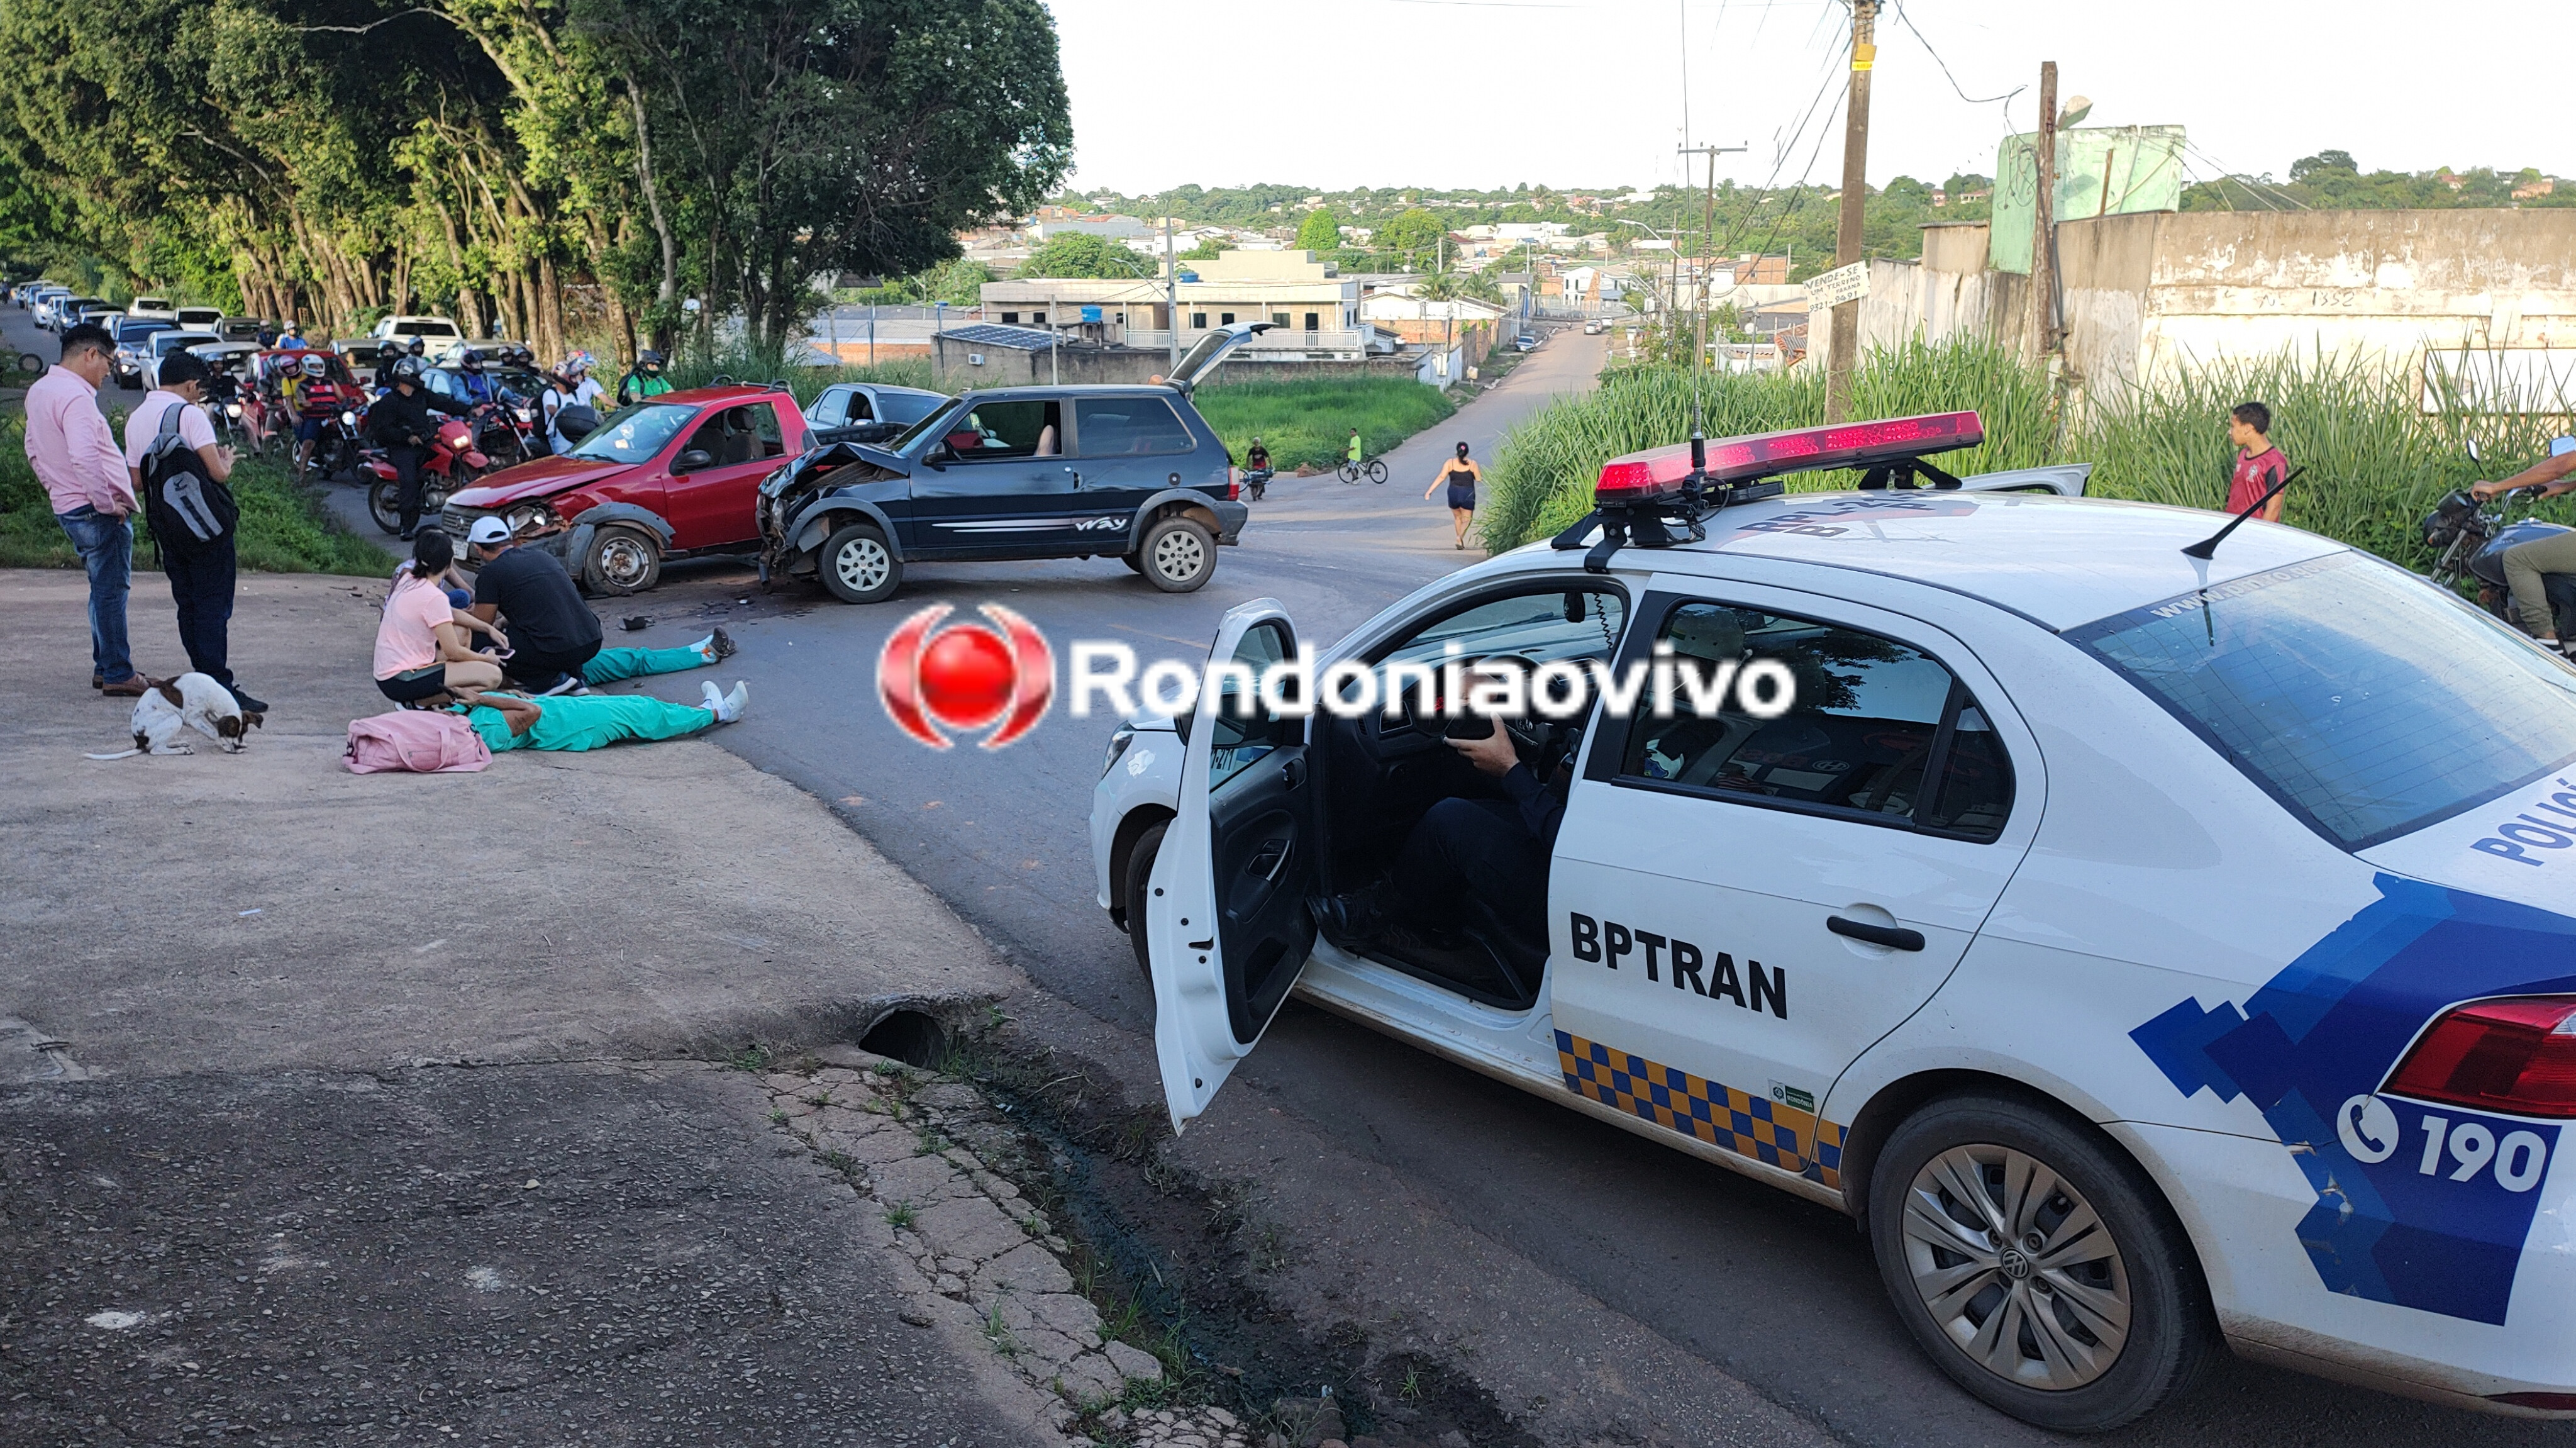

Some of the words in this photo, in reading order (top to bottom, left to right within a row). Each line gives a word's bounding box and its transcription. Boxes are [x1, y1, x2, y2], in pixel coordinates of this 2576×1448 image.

[1570, 911, 1787, 1020] BPTRAN
[1787, 1095, 1813, 1108] RONDÔNIA
[2419, 1115, 2546, 1193] 190
